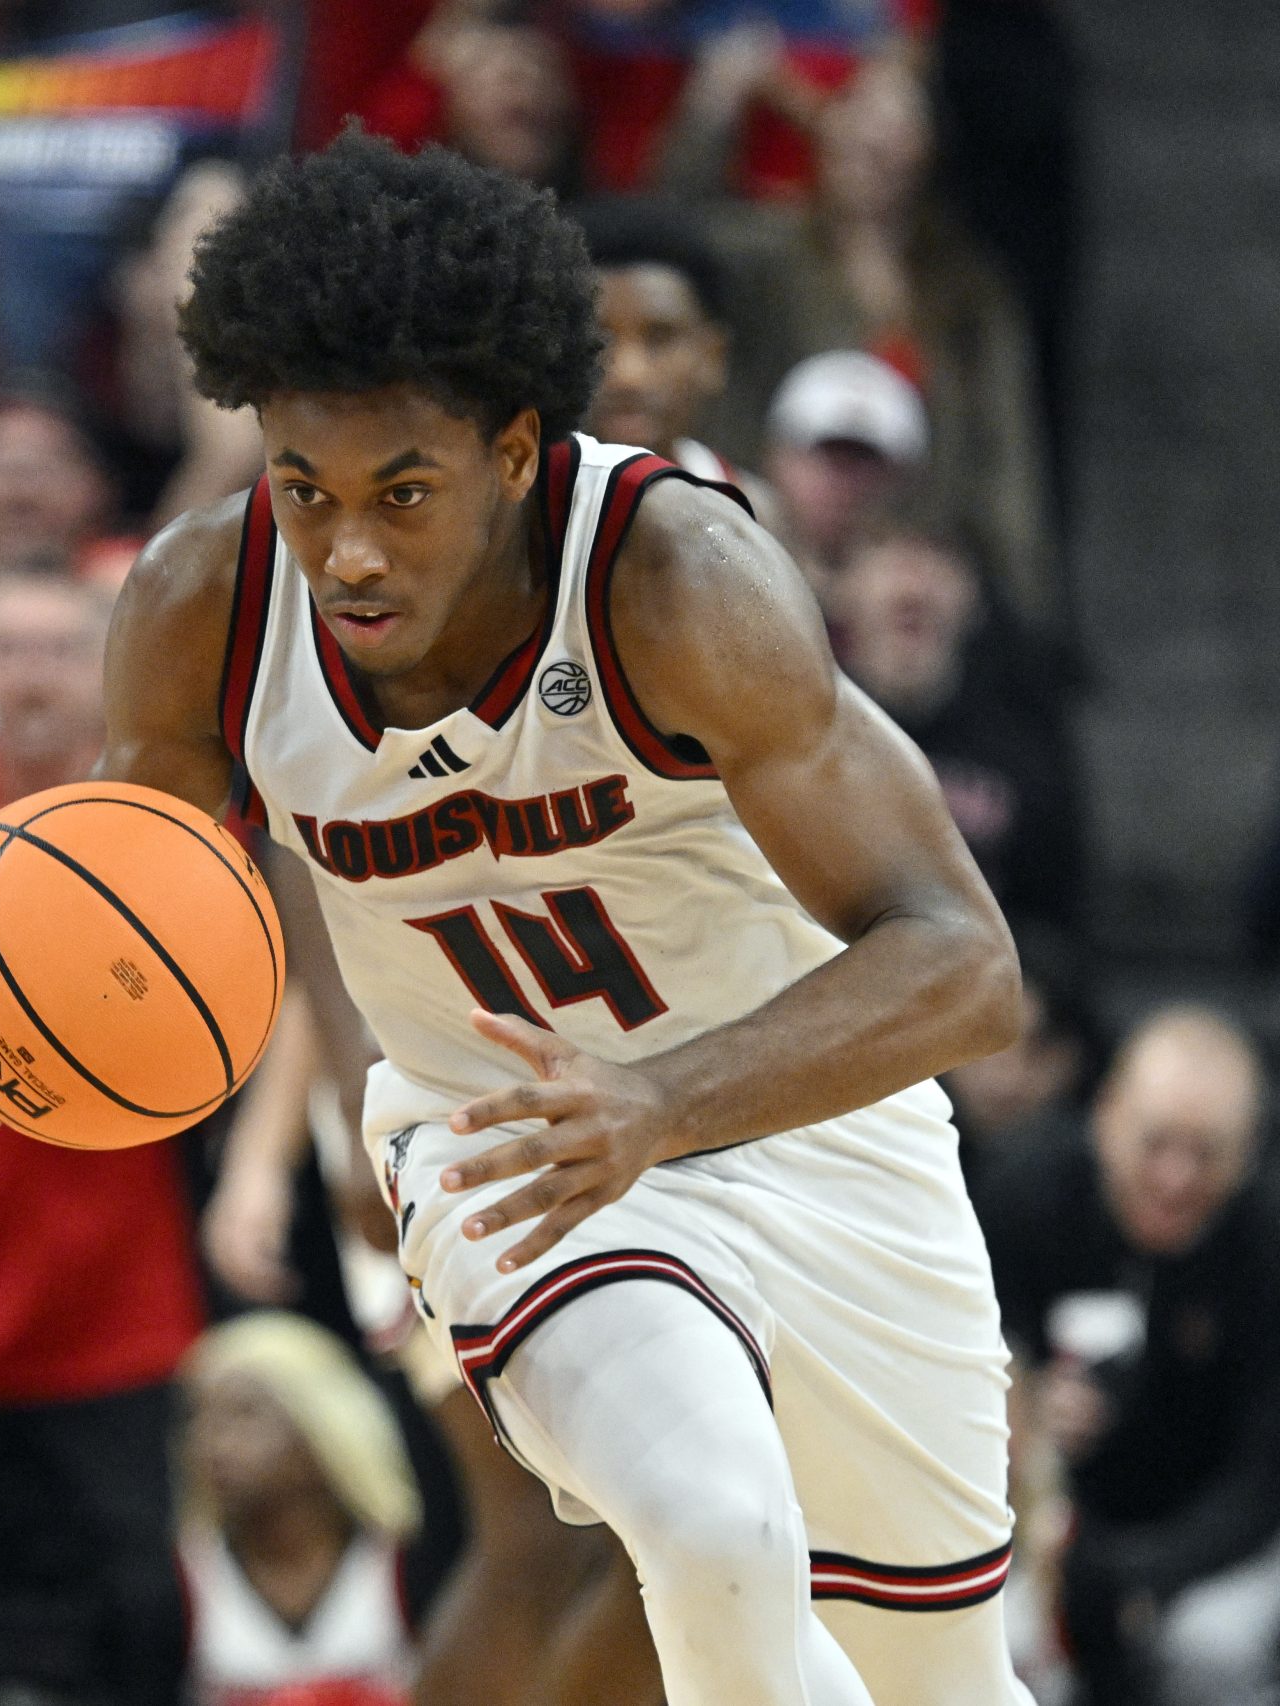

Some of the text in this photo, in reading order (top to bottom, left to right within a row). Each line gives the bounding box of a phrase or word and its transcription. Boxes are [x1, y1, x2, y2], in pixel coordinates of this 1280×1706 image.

[545, 678, 589, 692] ACC
[292, 773, 635, 882] LOUISVILLE
[402, 886, 669, 1032] 14
